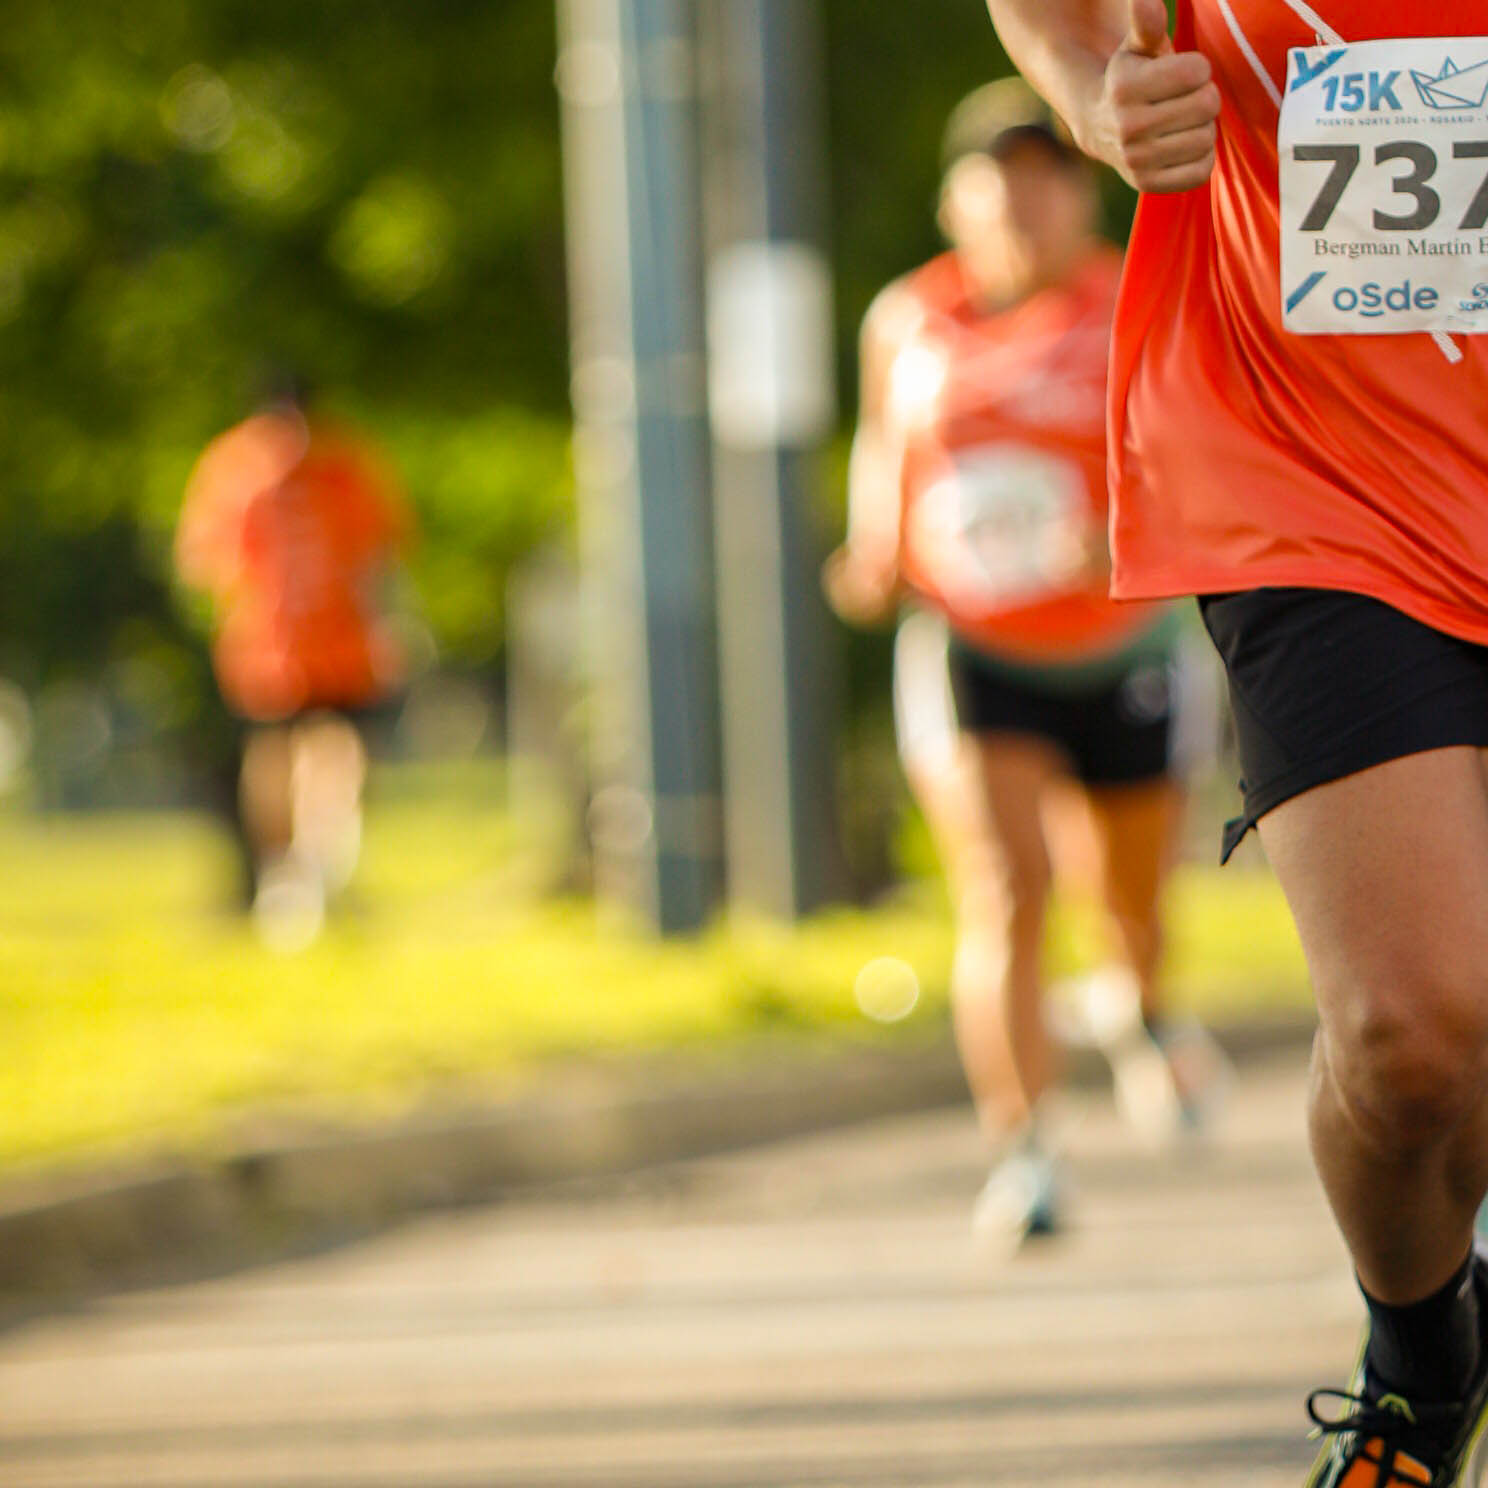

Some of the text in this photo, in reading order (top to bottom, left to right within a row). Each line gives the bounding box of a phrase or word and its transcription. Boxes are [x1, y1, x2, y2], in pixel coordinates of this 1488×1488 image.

[1321, 70, 1403, 113] 15K
[1315, 117, 1354, 127] PUERTO
[1358, 117, 1391, 127] NORTE
[1429, 115, 1474, 124] ROSARIO
[1314, 238, 1400, 258] Bergman
[1333, 280, 1438, 312] osde
